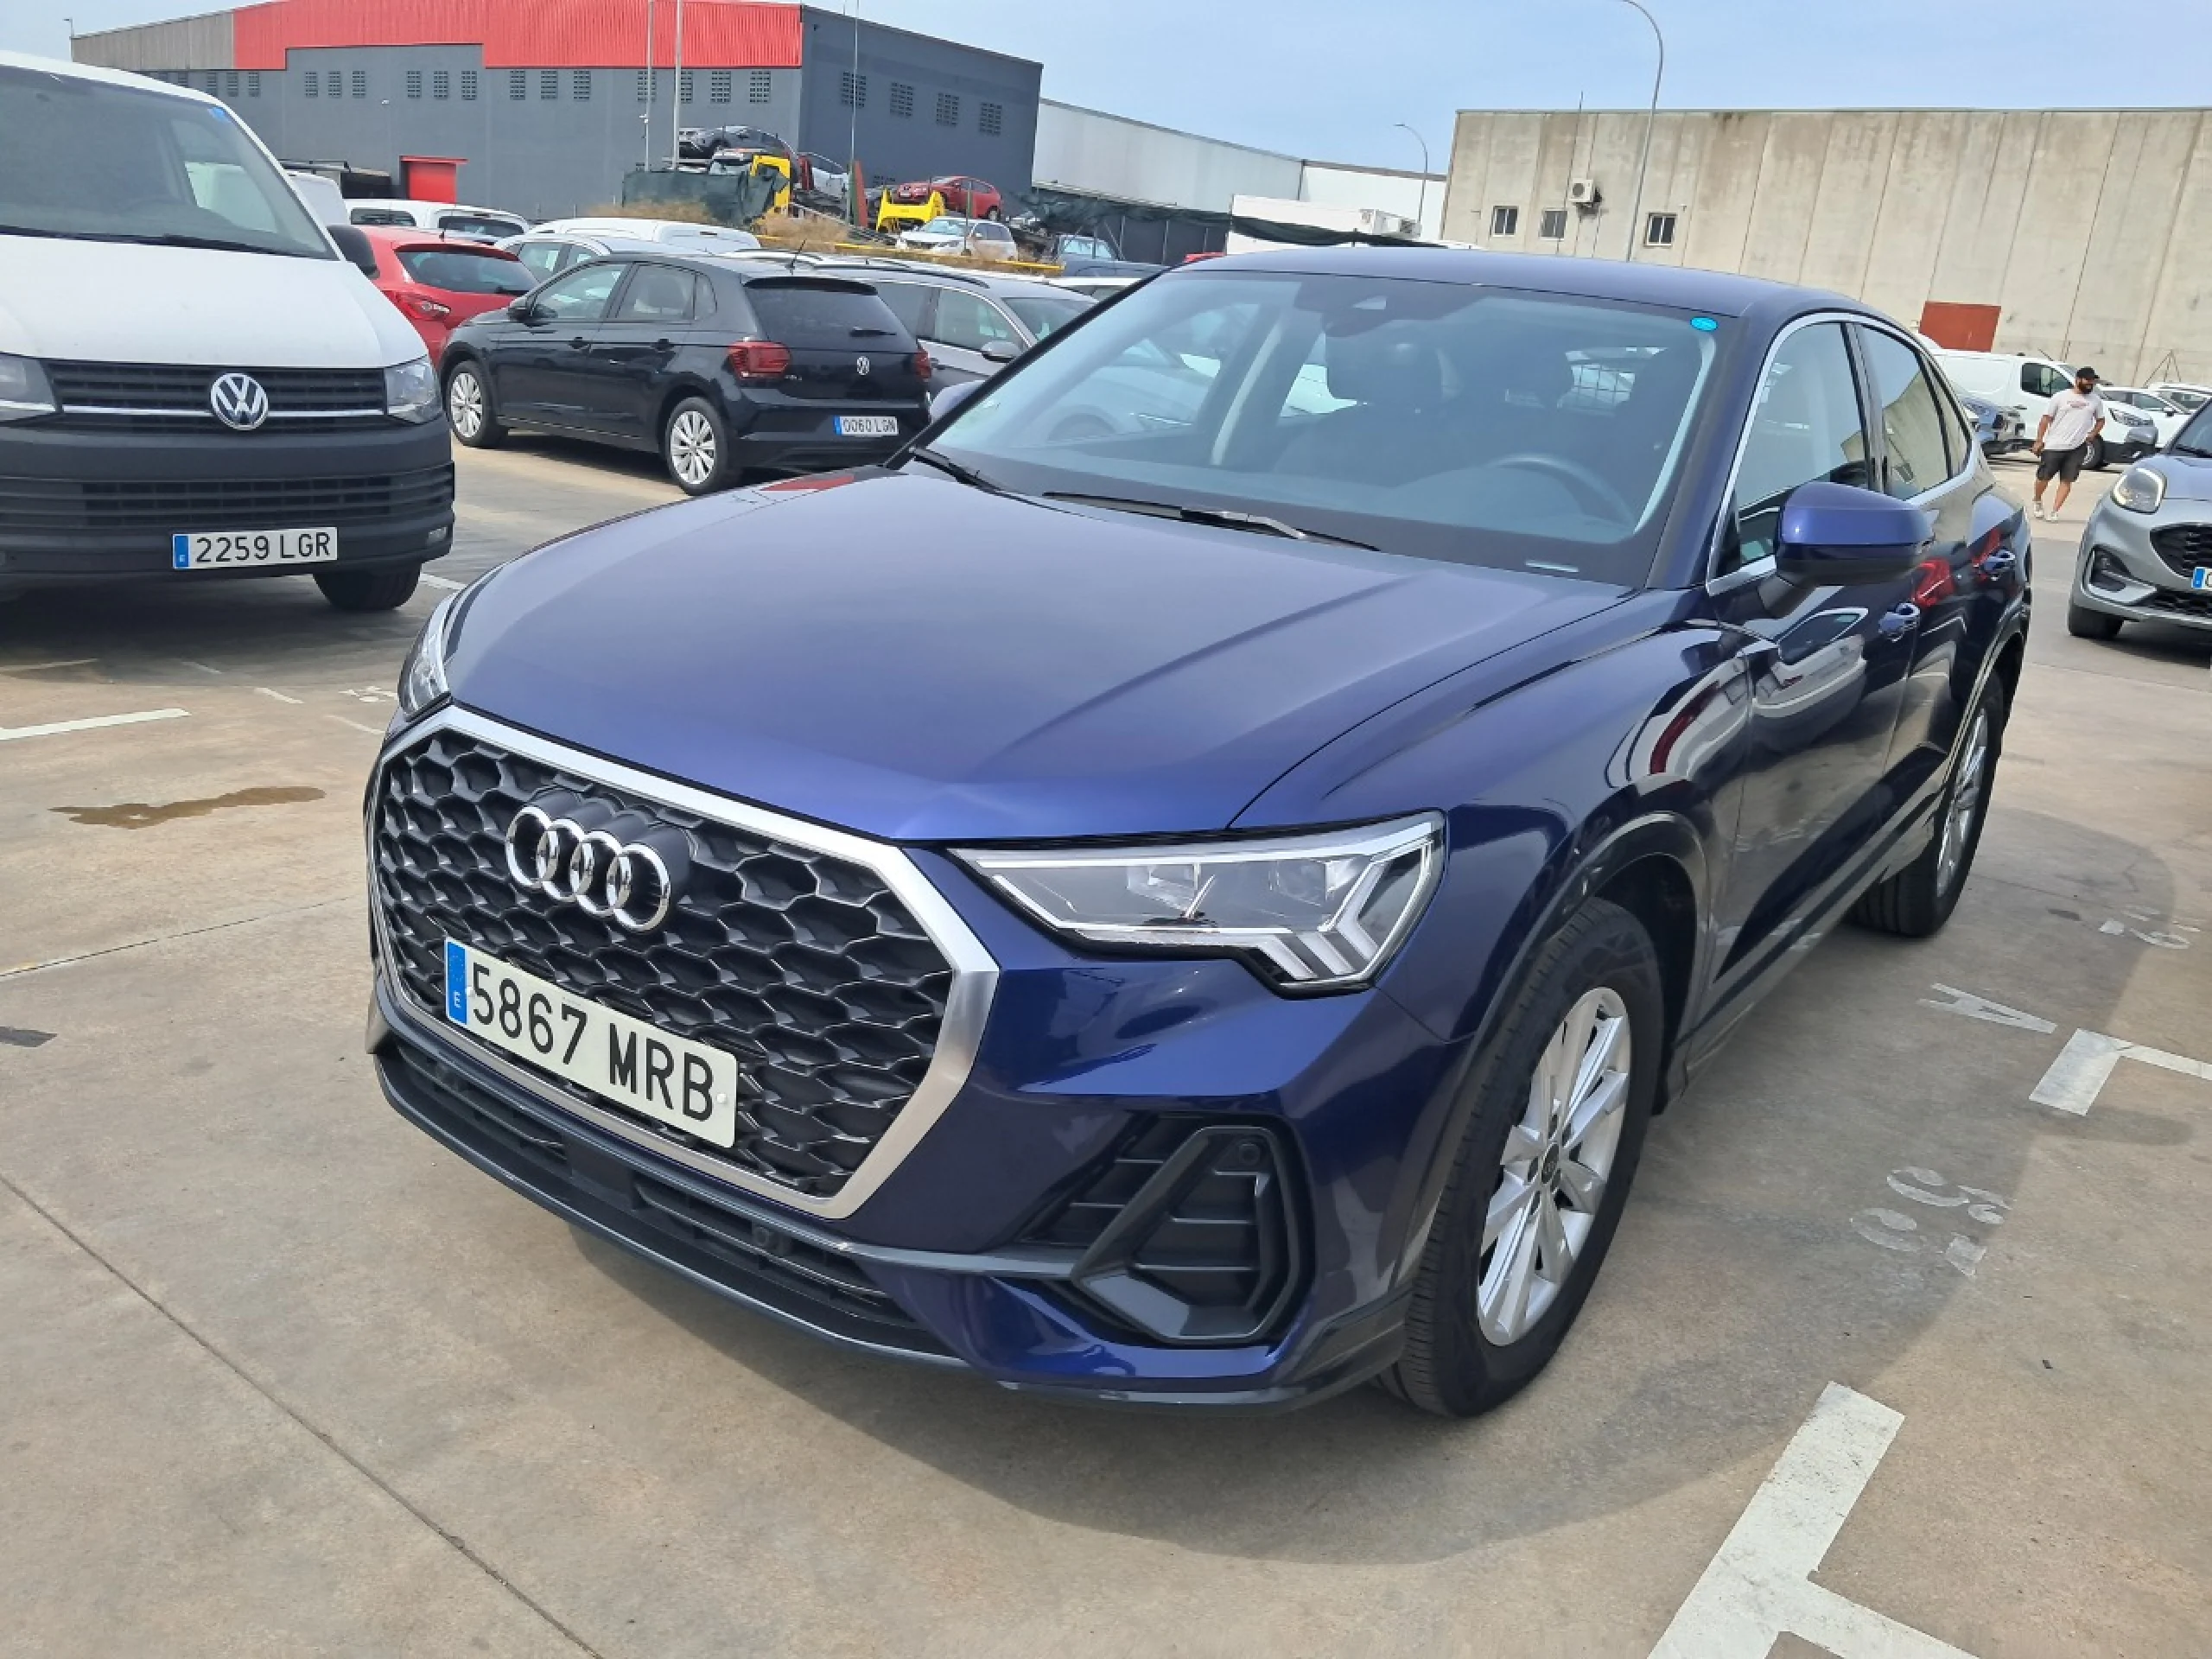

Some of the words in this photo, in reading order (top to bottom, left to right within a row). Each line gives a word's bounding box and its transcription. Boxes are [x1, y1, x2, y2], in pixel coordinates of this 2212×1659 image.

[843, 418, 871, 433] 0060
[195, 536, 270, 563] 2259
[279, 532, 330, 559] LGR
[454, 990, 461, 1008] E
[473, 962, 588, 1065] 5867
[610, 1022, 714, 1122] MRB
